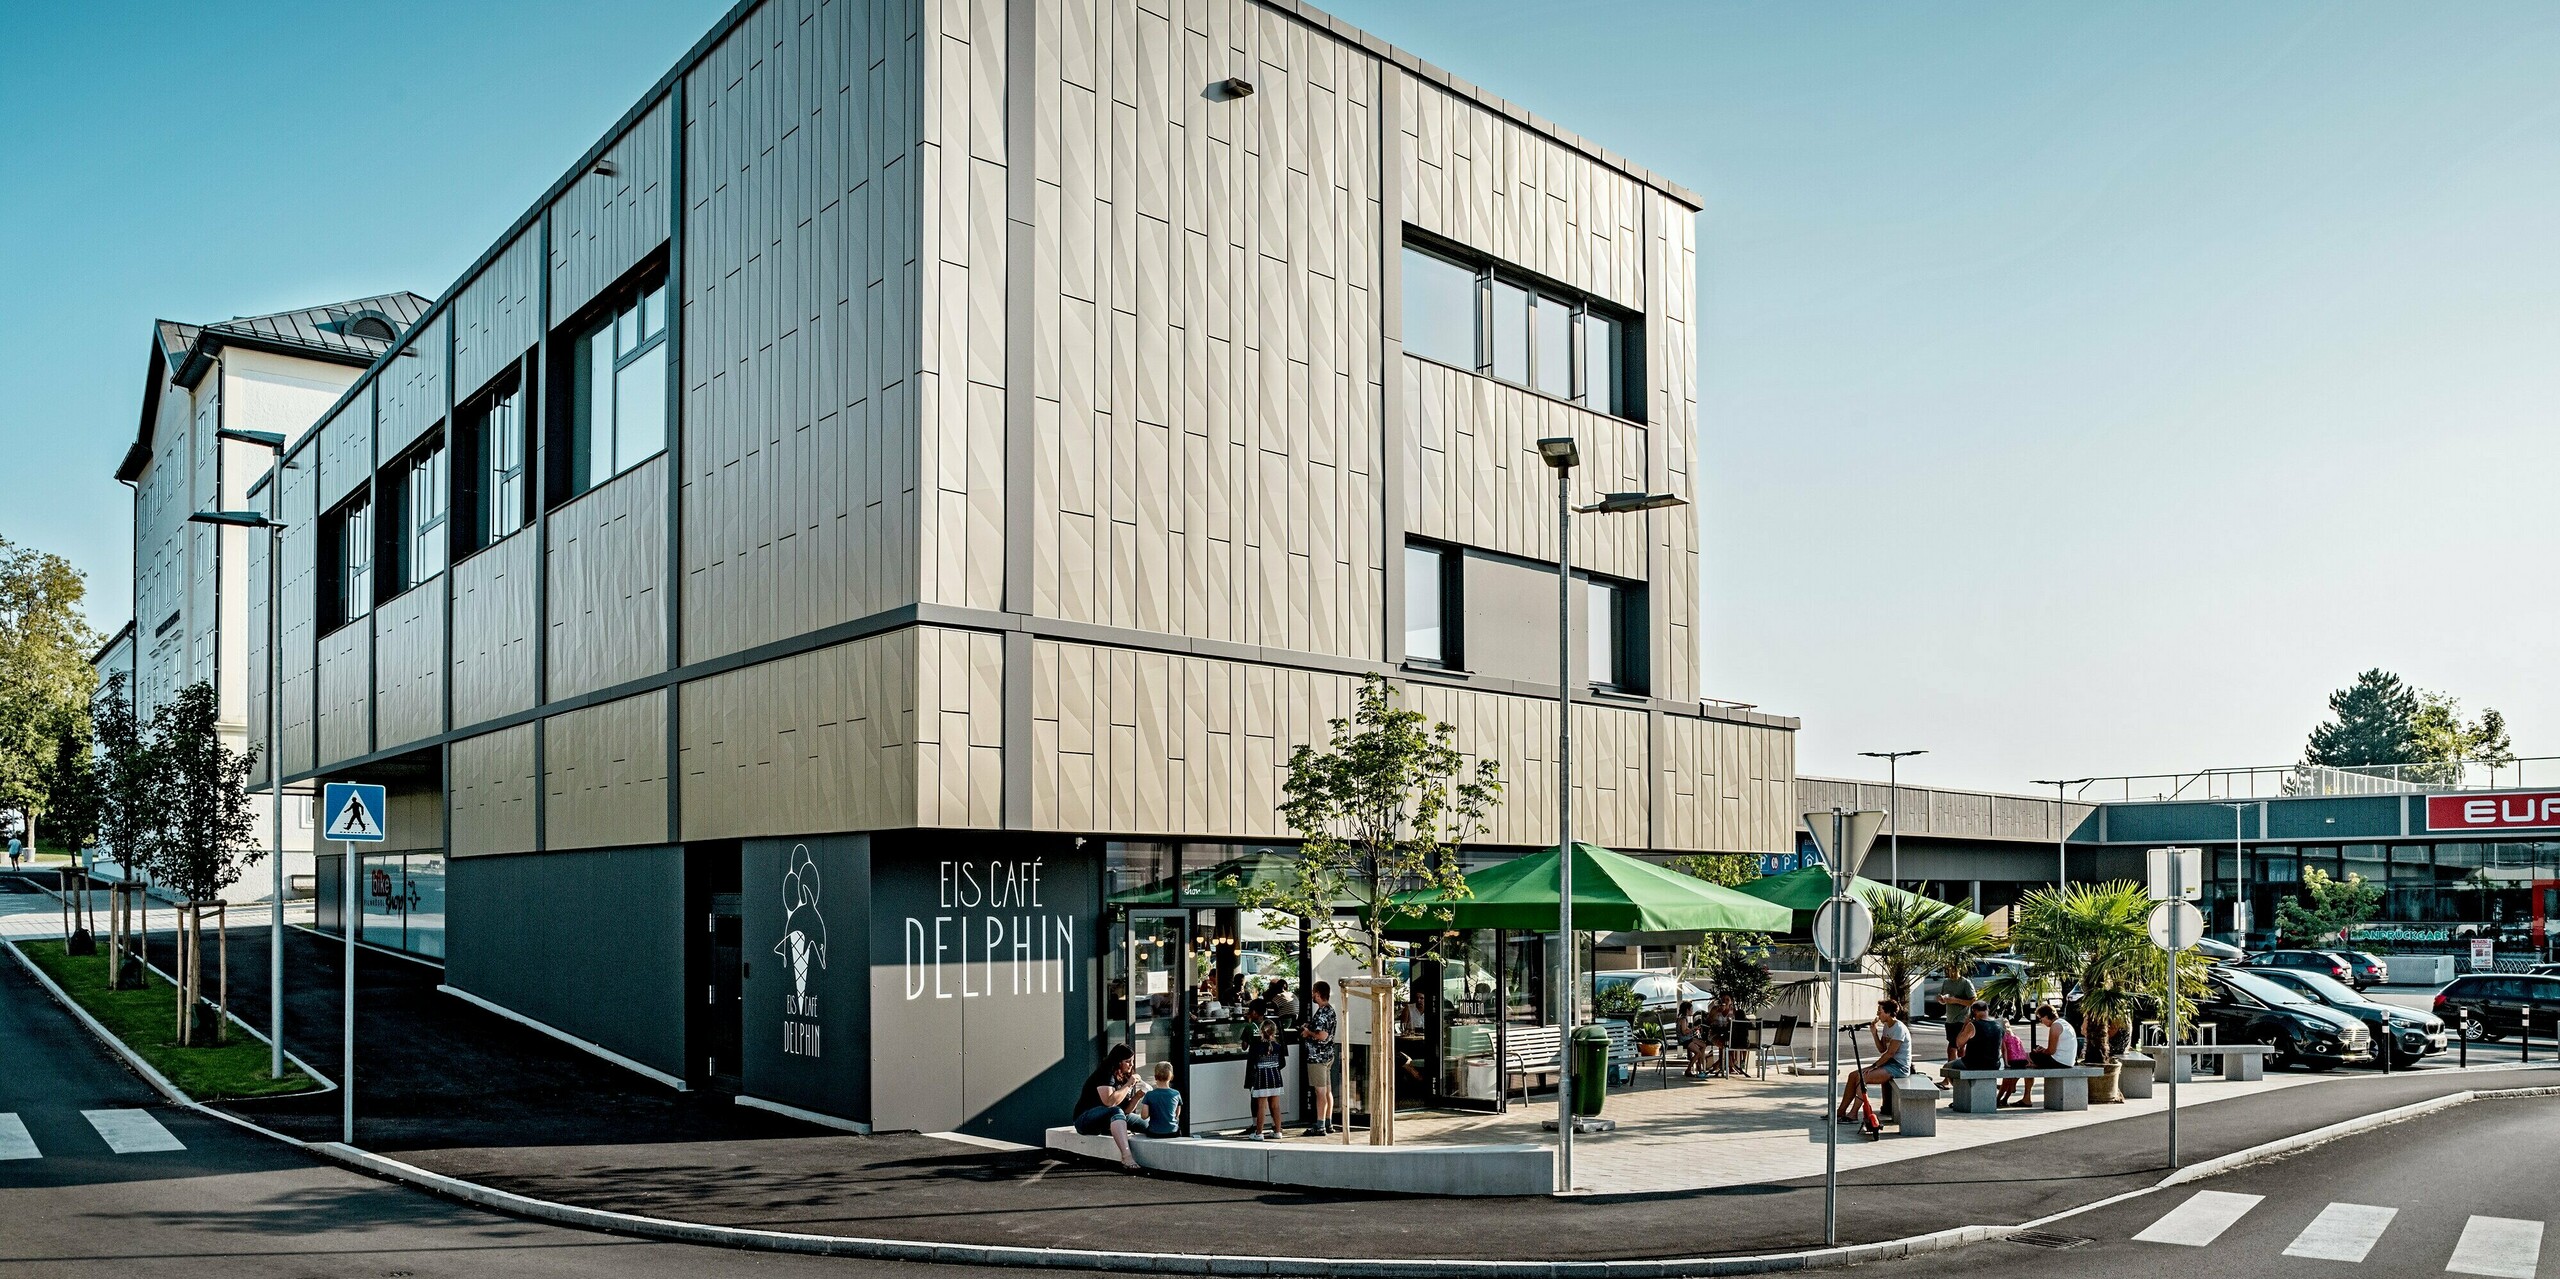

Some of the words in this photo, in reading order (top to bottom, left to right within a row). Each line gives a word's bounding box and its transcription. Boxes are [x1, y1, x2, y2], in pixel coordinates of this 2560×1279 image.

[372, 872, 390, 894] bike
[940, 860, 982, 909] EIS
[990, 856, 1043, 908] CAFÉ
[905, 914, 1074, 1001] DELPHIN
[786, 995, 797, 1017] EIS
[804, 994, 818, 1018] CAFÉ
[783, 1020, 821, 1058] DELPHIN
